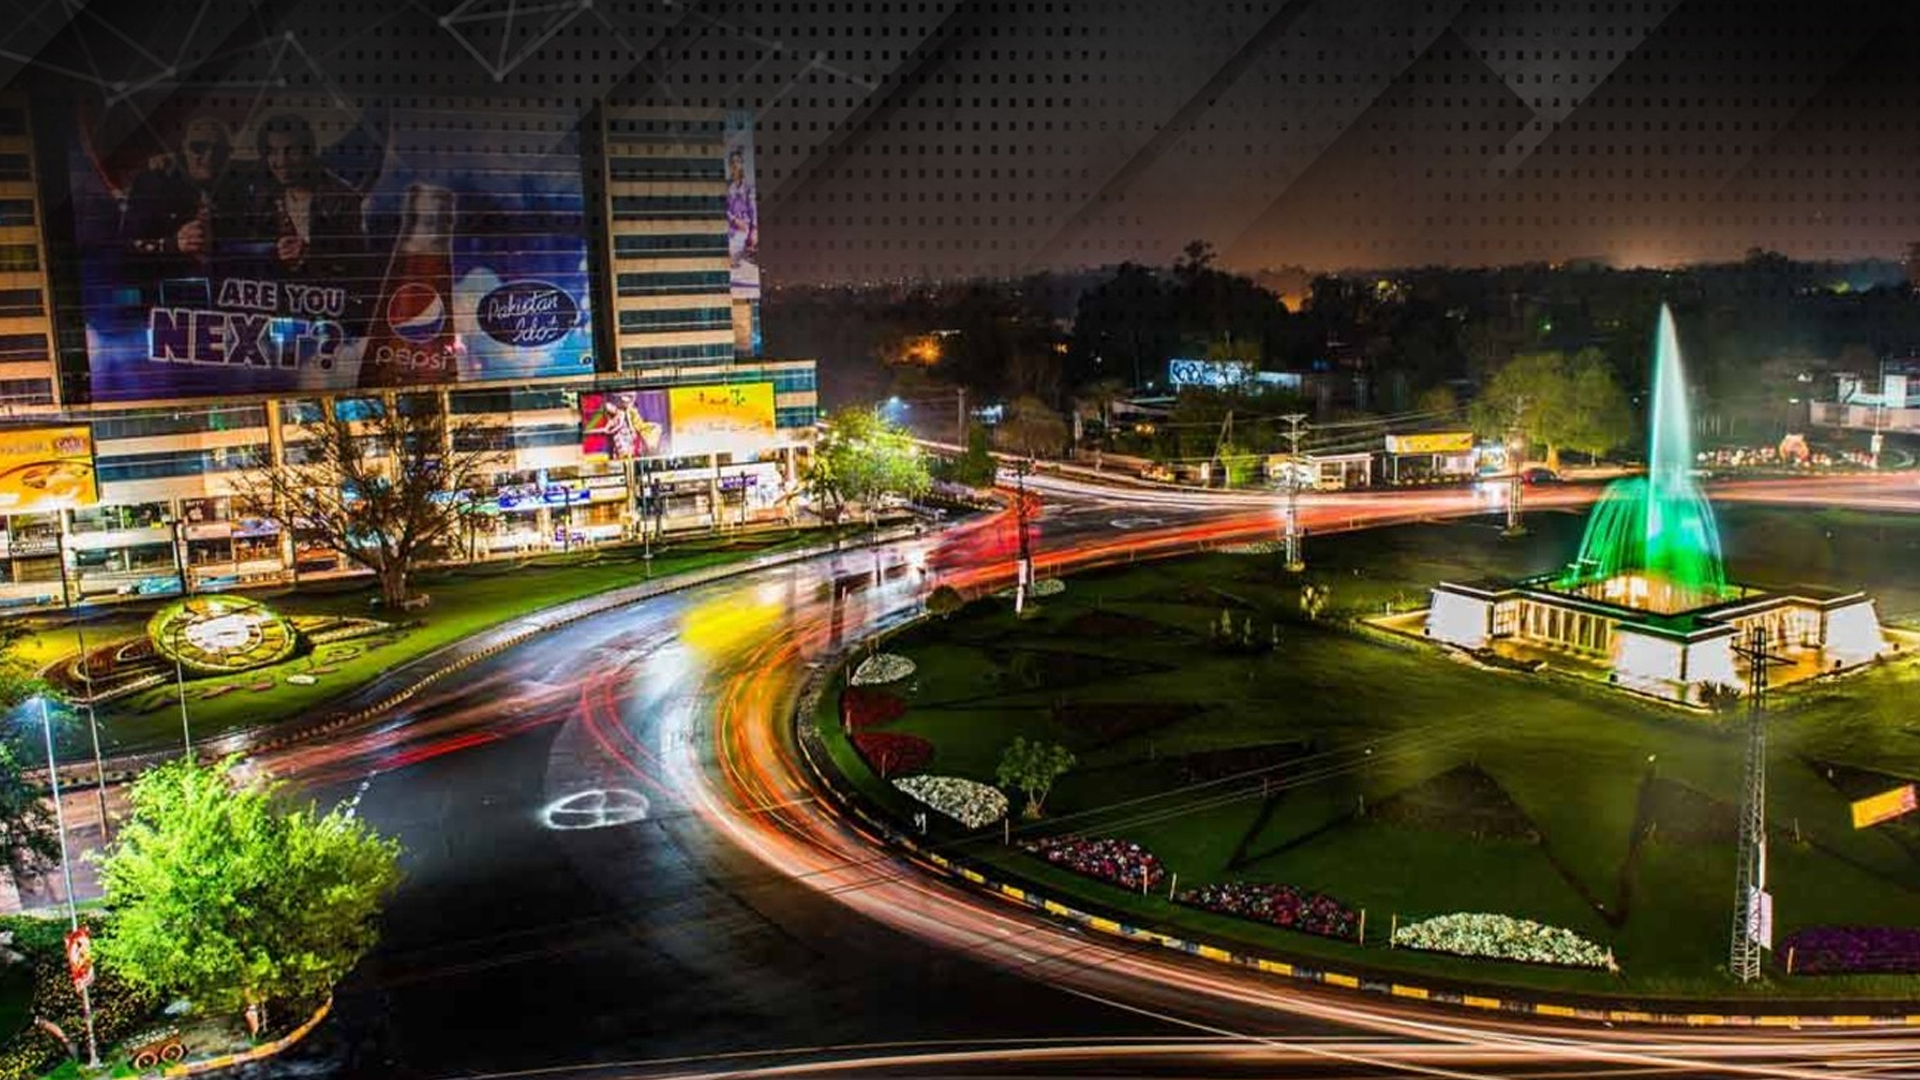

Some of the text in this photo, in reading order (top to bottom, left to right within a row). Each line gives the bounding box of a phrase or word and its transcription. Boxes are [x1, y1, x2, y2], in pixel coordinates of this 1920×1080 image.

[218, 278, 345, 316] ARE YOU
[488, 289, 558, 322] Pakistan
[149, 308, 343, 371] NEXT?
[376, 346, 448, 370] pepsi
